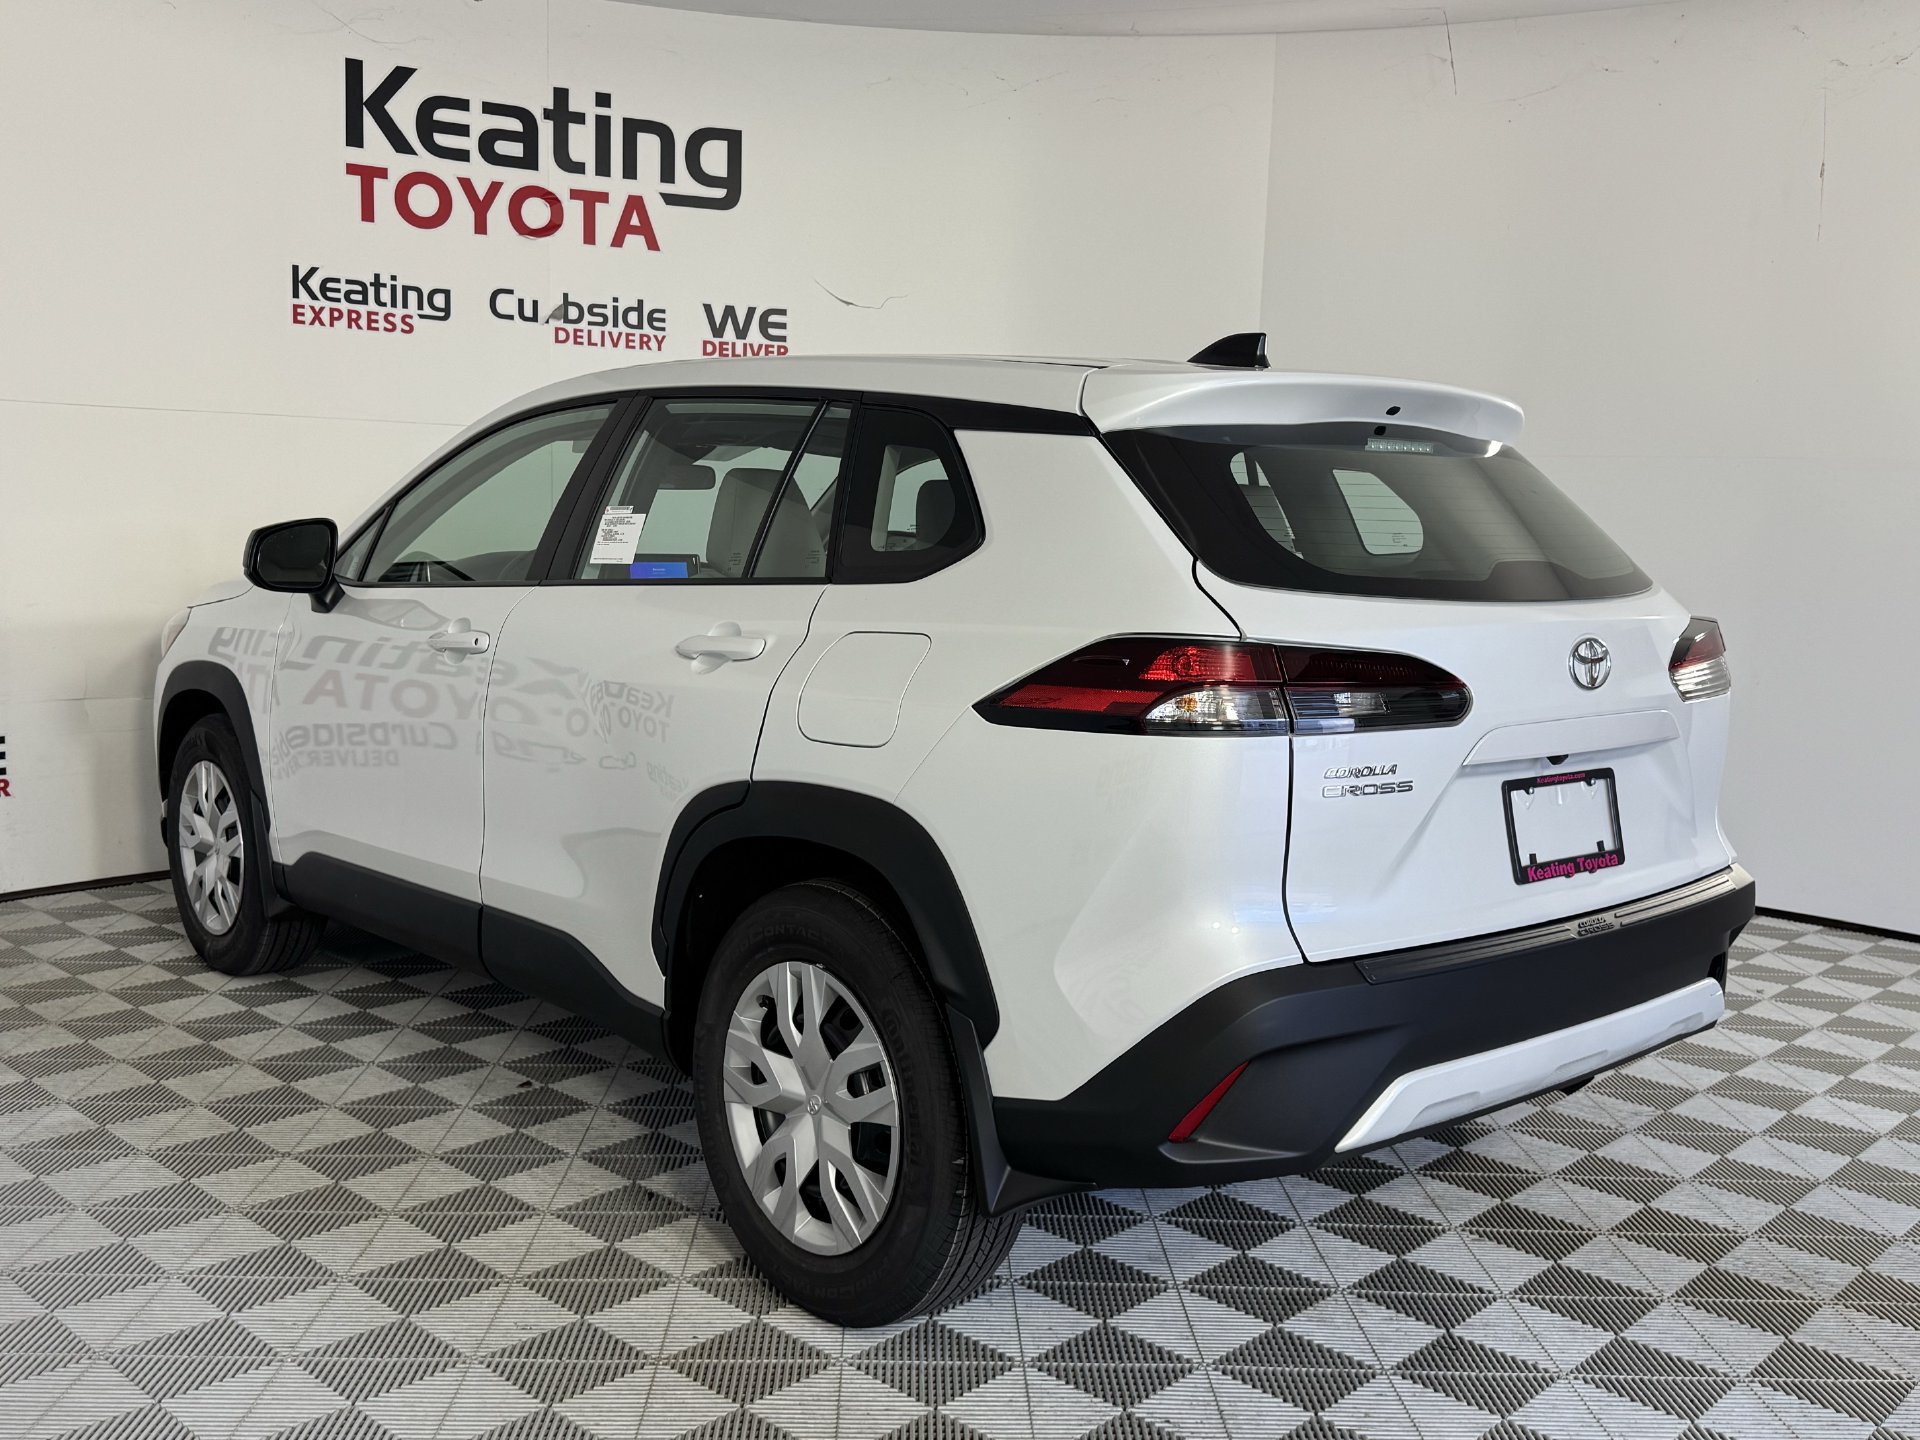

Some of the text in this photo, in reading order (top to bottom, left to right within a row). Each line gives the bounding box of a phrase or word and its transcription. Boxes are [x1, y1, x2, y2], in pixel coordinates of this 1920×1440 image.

[345, 57, 743, 210] Keating
[345, 162, 661, 252] TOYOTA
[291, 264, 451, 321] Keating
[489, 287, 667, 332] Cubside
[291, 303, 415, 335] EXPRESS
[702, 302, 788, 342] WE
[554, 326, 667, 352] DELIVERY
[1322, 779, 1414, 798] CROSS
[1323, 763, 1398, 779] COROLLA
[1527, 852, 1620, 882] Keating Toyota
